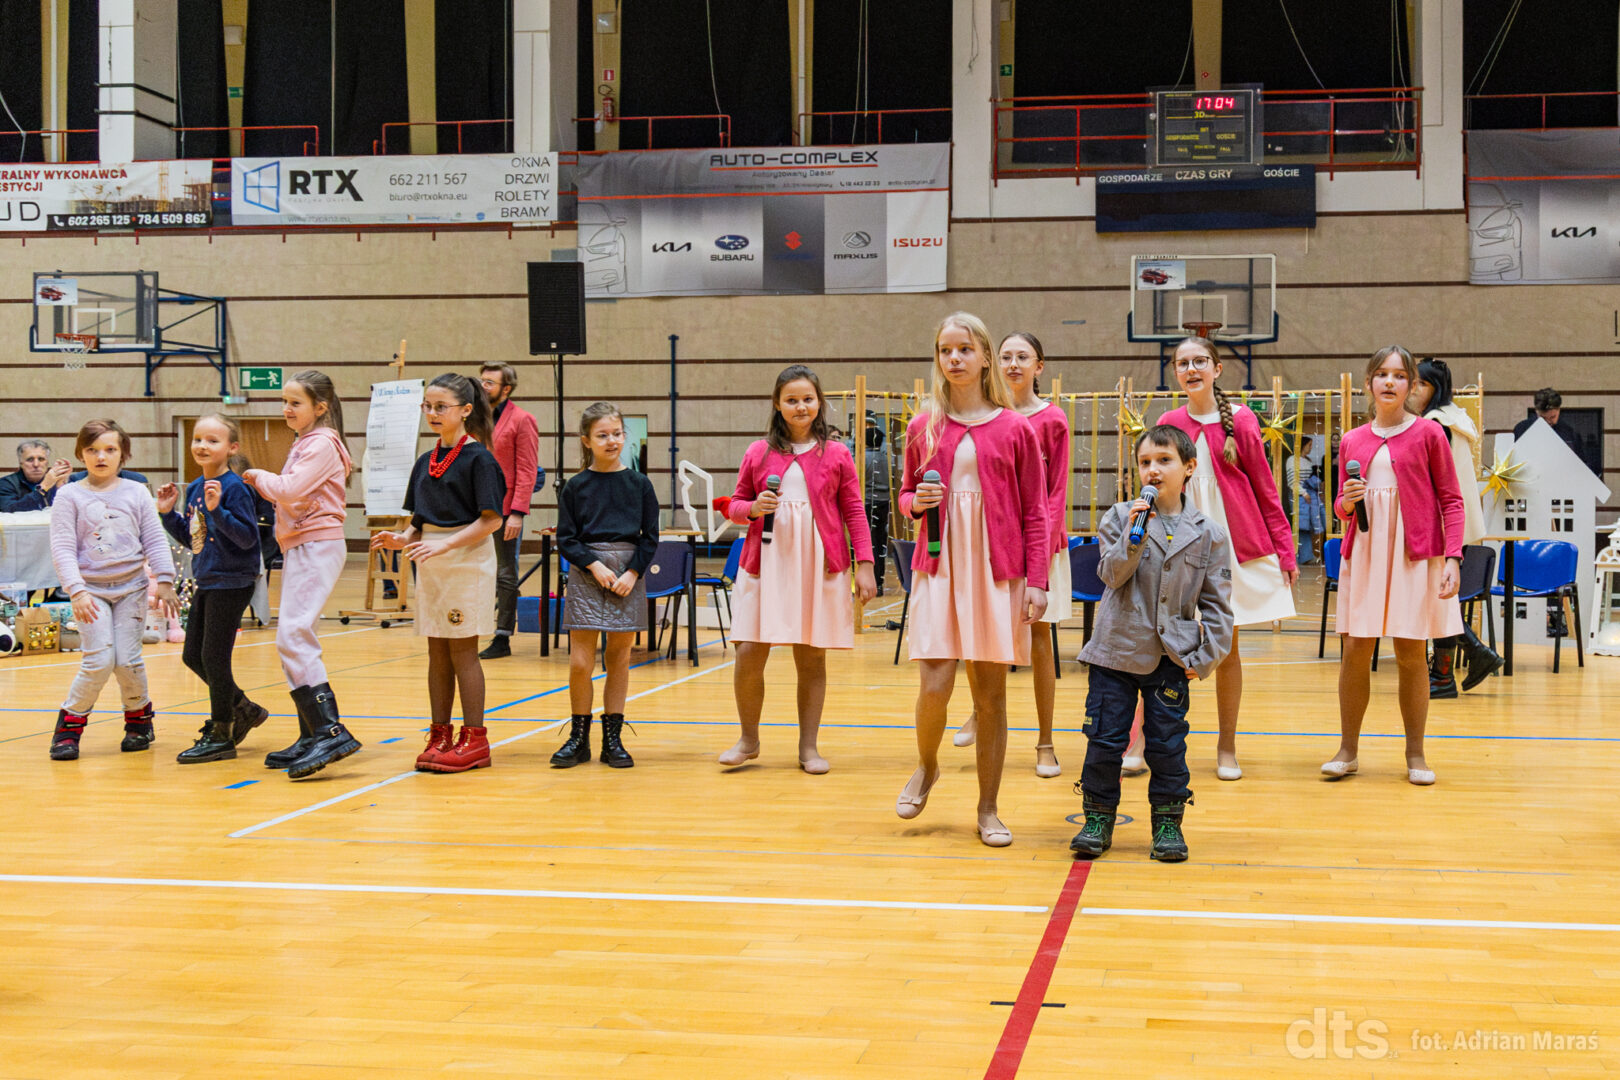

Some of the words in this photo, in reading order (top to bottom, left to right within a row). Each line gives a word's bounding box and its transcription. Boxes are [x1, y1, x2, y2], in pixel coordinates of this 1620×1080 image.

[511, 157, 550, 168] OKNA
[710, 151, 878, 166] AUTO-COMPLEX
[0, 170, 41, 180] RALNY
[44, 169, 128, 180] WYKONAWCA
[1098, 173, 1163, 184] GOSPODARZE
[1175, 170, 1206, 181] CZAS
[1208, 169, 1233, 180] GRY
[1263, 168, 1300, 178] GOŚCIE
[389, 174, 413, 186] 662
[416, 173, 439, 185] 211
[444, 173, 467, 185] 567
[505, 173, 549, 185] DRZWI
[0, 182, 43, 192] STYCJI
[289, 169, 364, 202] RTX
[494, 190, 550, 202] ROLETY
[501, 206, 550, 218] BRAMY
[68, 216, 88, 226] 602
[90, 215, 110, 226] 265
[112, 214, 130, 225] 125
[137, 214, 160, 225] 784
[162, 213, 183, 224] 509
[185, 213, 207, 224] 862
[893, 237, 943, 248] ISUZU
[710, 254, 755, 262] SUBARU
[833, 252, 878, 260] MAXUS
